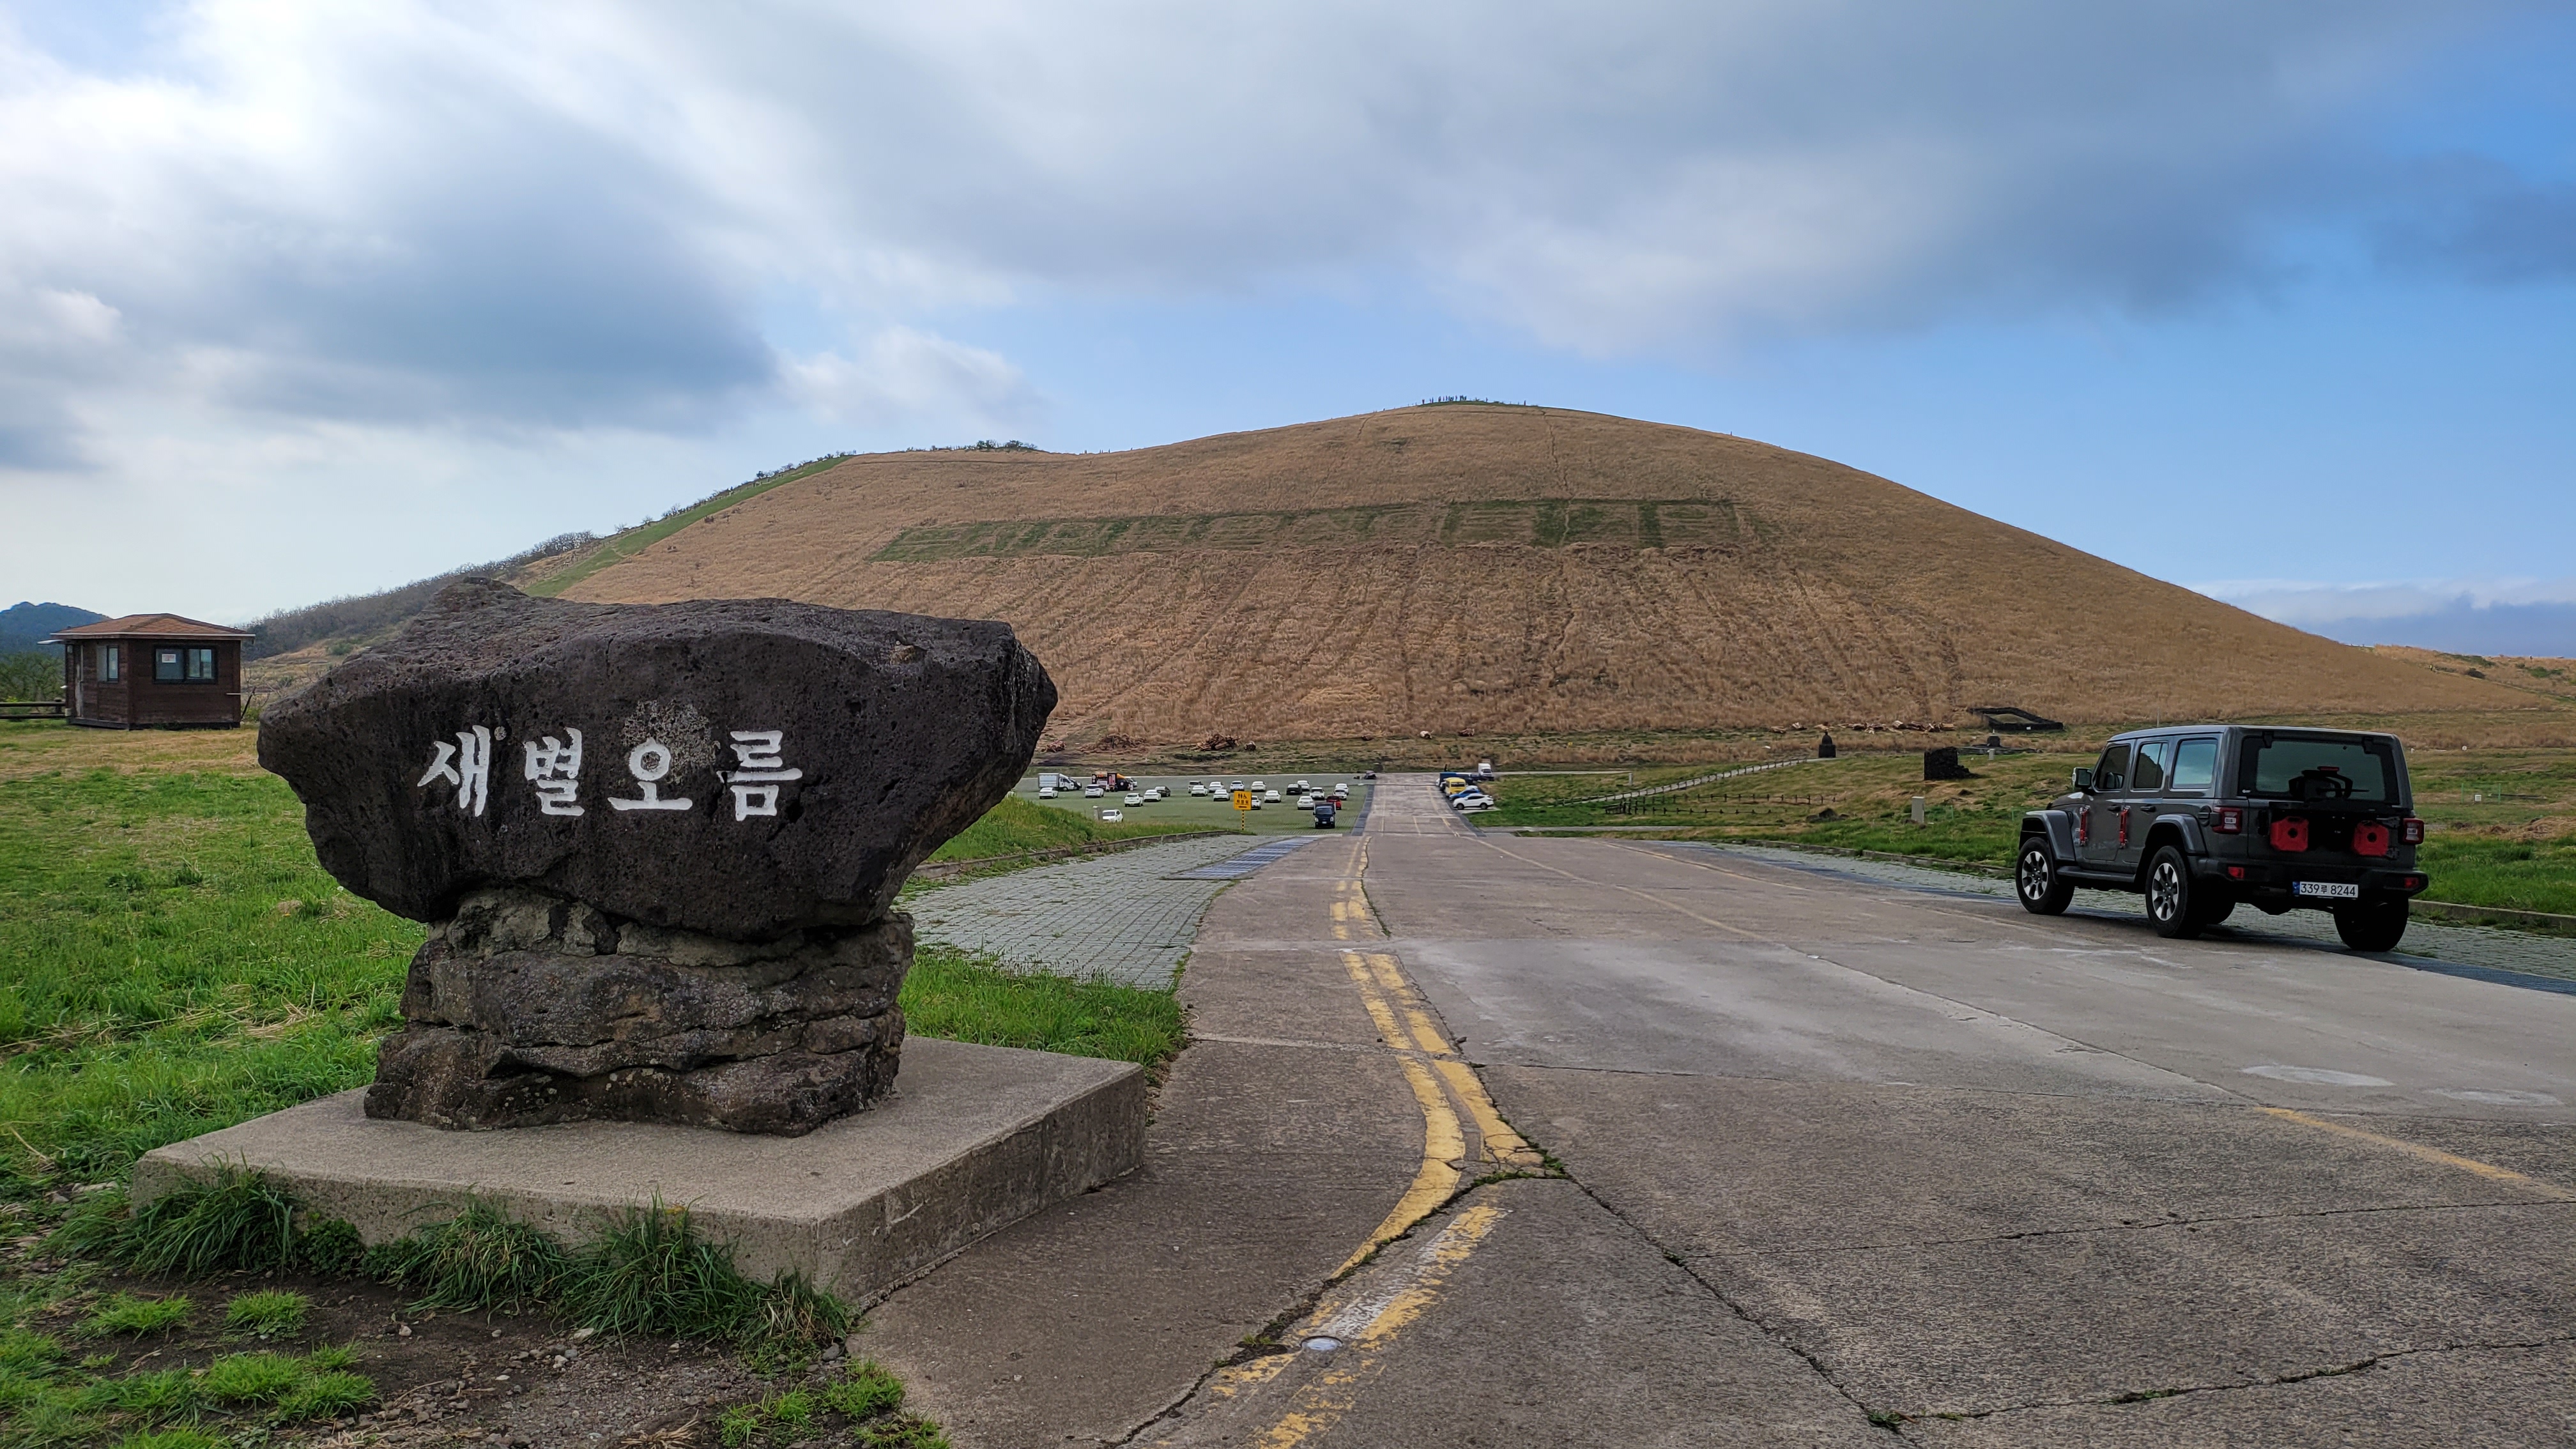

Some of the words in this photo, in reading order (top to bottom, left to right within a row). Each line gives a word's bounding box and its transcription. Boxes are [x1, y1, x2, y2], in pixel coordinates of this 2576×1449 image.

[417, 724, 803, 822] 새별오름
[2301, 883, 2327, 894] 339루
[2330, 885, 2356, 896] 8244
